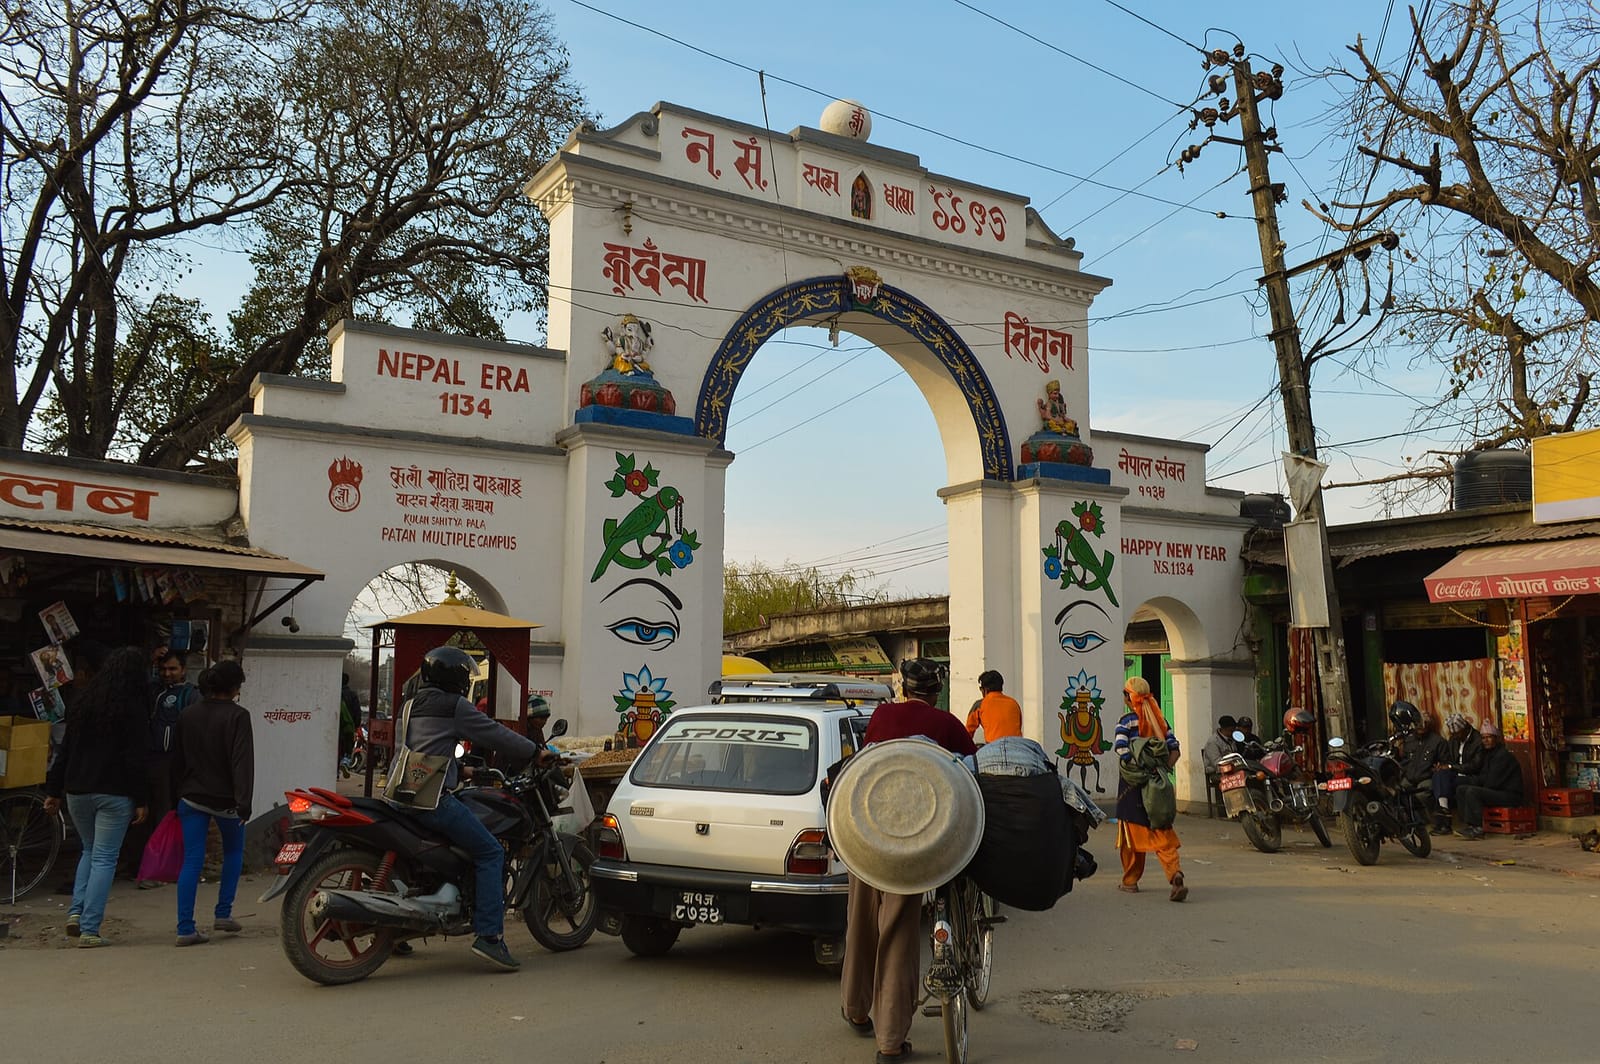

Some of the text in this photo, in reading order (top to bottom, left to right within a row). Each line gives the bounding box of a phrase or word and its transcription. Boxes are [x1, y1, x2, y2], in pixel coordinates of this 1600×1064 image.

[377, 349, 530, 393] NEPAL ERA
[439, 392, 492, 420] 1134
[1118, 448, 1153, 480] नेपाल
[431, 516, 463, 528] SAHITYA
[466, 519, 487, 530] PALA
[382, 527, 517, 551] PATAN MULTIPLE CAMPUS
[1120, 538, 1227, 561] HAPPY NEW YEAR
[1434, 580, 1482, 599] Coca-Cola
[1496, 577, 1548, 595] गोपाल
[1552, 576, 1590, 592] कोल्ड
[666, 728, 802, 743] SPORTS
[675, 904, 720, 923] ८७३४
